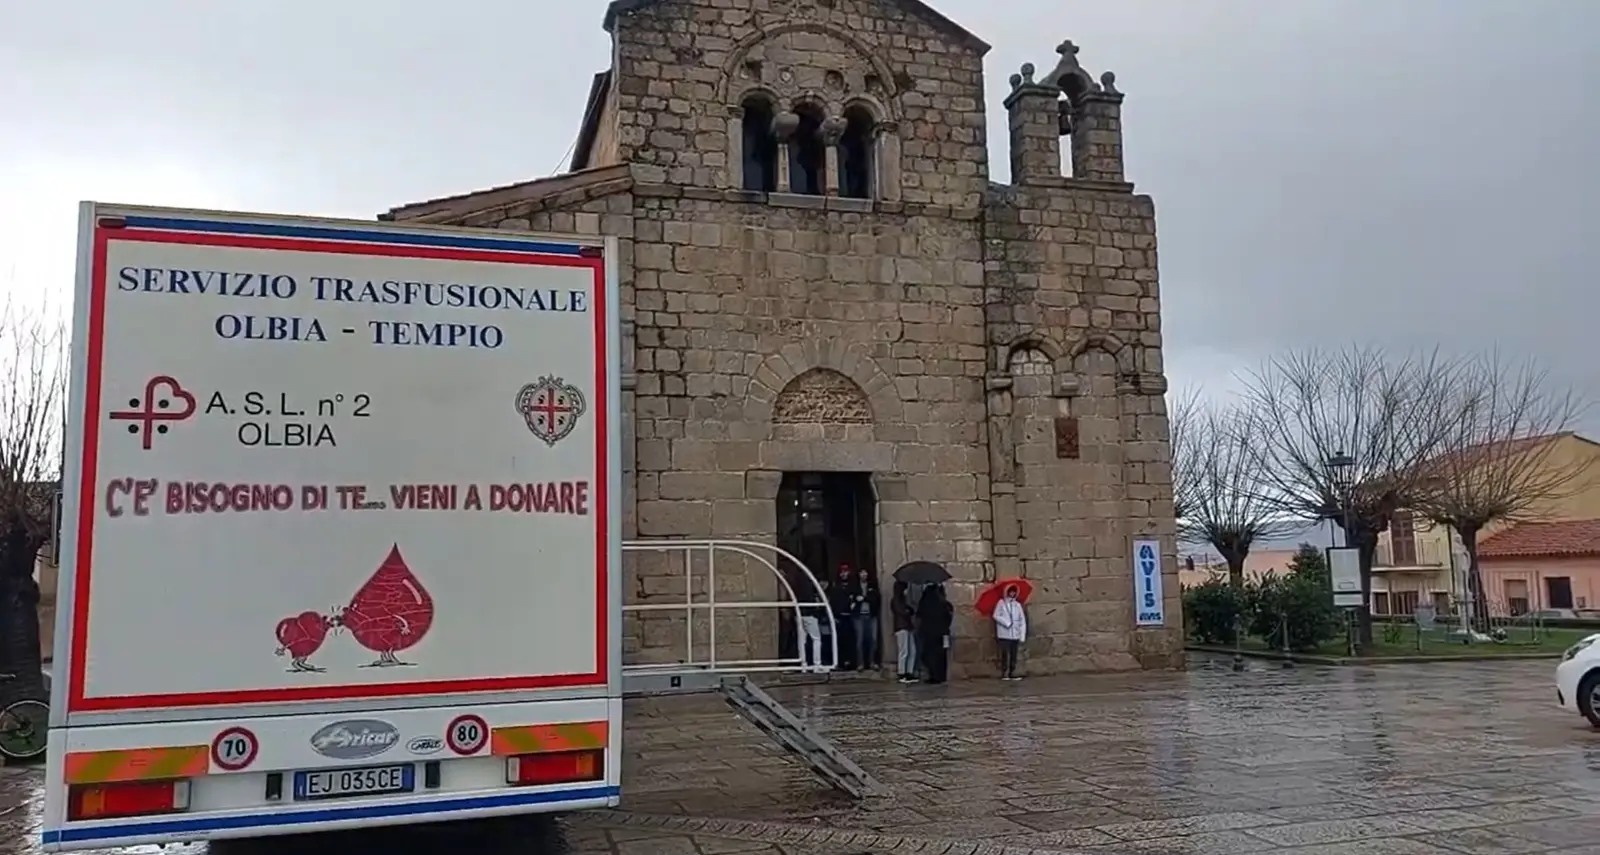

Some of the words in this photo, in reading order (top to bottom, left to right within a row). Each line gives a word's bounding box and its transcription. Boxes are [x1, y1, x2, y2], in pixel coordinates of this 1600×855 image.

[118, 266, 297, 299] SERVIZIO
[310, 276, 588, 312] TRASFUSIONALE
[215, 314, 328, 342] OLBIA
[368, 320, 503, 349] TEMPIO
[353, 394, 371, 417] 2
[238, 422, 337, 447] OLBIA
[165, 482, 294, 515] BISOGNO
[301, 485, 328, 511] DI
[389, 484, 458, 511] VIENI
[463, 483, 483, 511] A
[489, 480, 589, 516] DONARE
[1139, 544, 1156, 608] AVIS
[457, 725, 478, 742] 80
[223, 738, 247, 757] 70
[309, 772, 333, 794] EJ
[341, 768, 401, 791] 035CE
